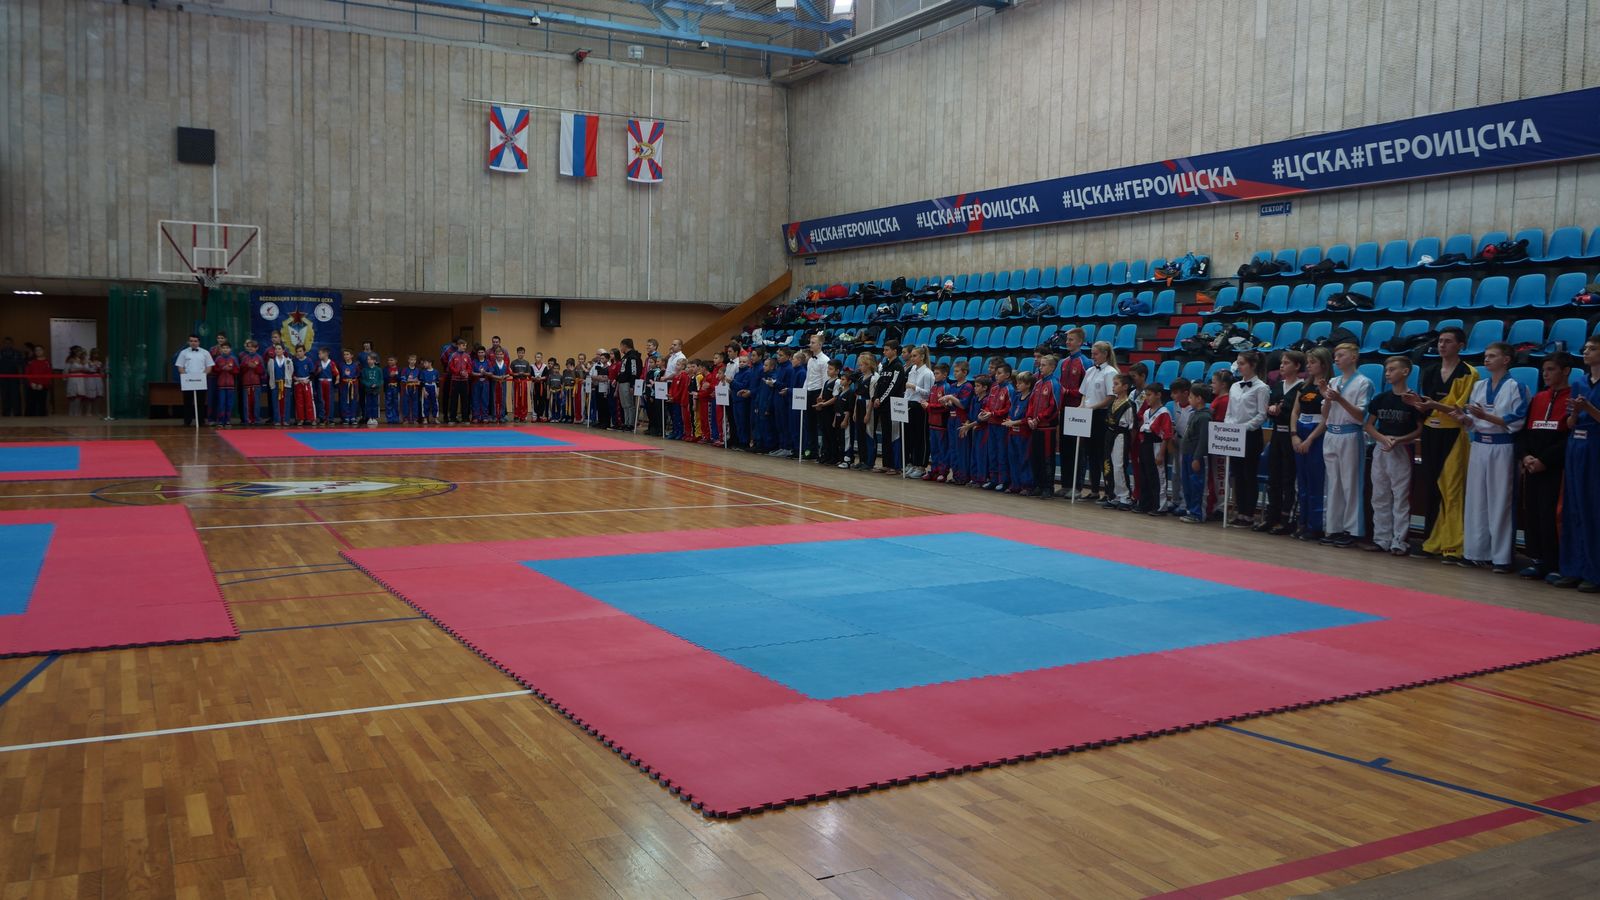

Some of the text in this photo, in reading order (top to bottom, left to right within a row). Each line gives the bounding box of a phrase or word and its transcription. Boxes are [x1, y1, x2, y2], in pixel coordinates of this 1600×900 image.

[1271, 118, 1542, 182] #ЦСКА#ГЕРОИЦСКА
[1062, 166, 1237, 210] #ЦСКА#ГЕРОИЦСКА
[916, 195, 1040, 230] #ЦСКА#ГЕРОИЦСКА
[1261, 205, 1284, 214] СЕКТОР
[809, 216, 901, 245] #ЦСКА#ГЕРОИЦСКА
[1211, 443, 1241, 452] Республика
[1214, 434, 1239, 442] Народная
